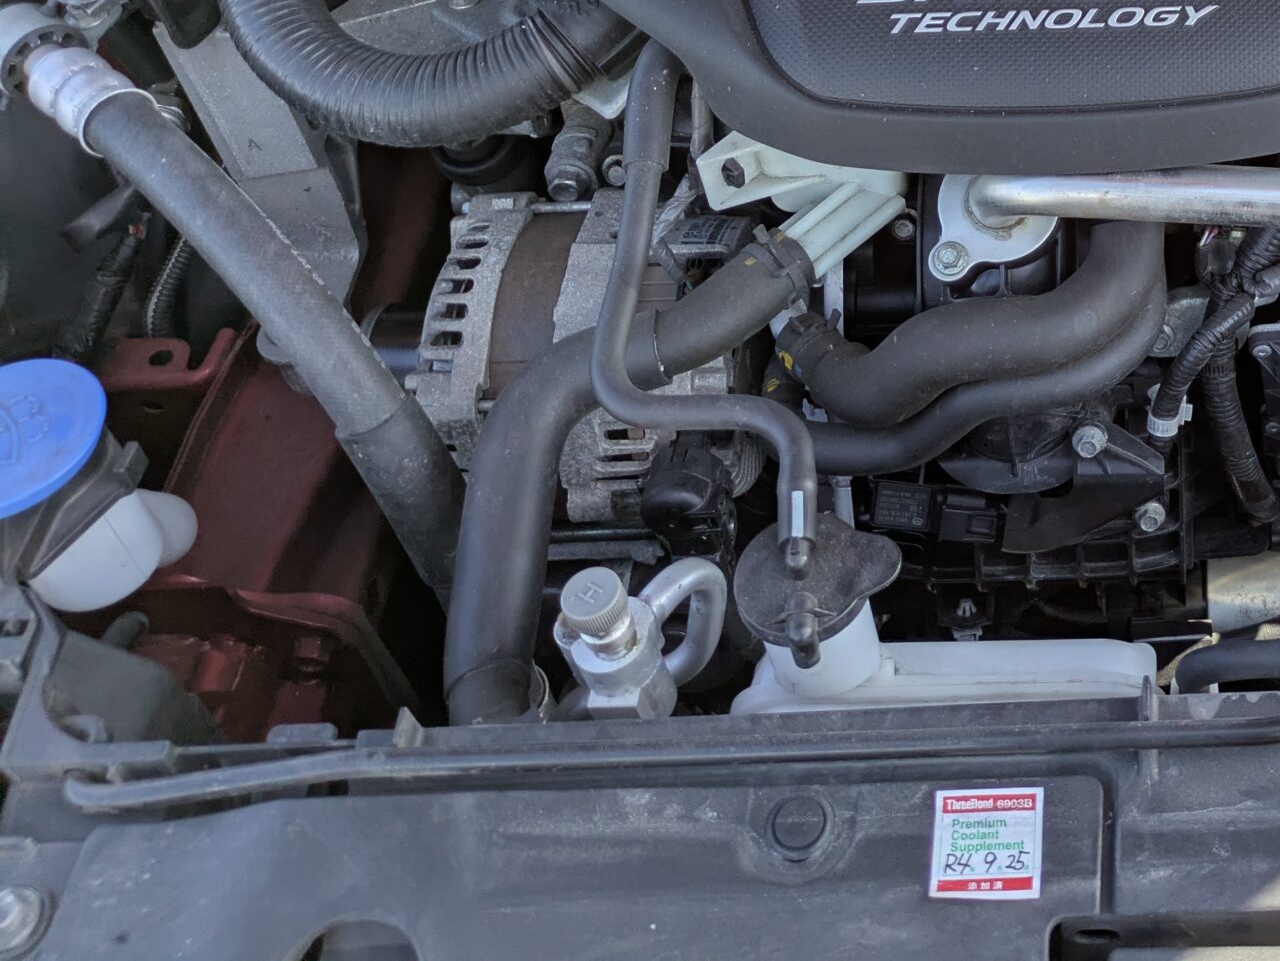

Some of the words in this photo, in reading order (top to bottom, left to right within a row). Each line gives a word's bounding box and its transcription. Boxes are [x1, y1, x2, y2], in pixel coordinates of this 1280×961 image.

[890, 4, 1220, 34] TECHNOLOGY
[577, 581, 604, 604] H
[945, 798, 994, 810] ThreeBond
[996, 798, 1033, 808] 6903B
[951, 818, 1007, 829] Premium
[951, 829, 999, 841] Coolant
[950, 840, 1025, 854] Supplement
[944, 853, 973, 875] R4
[984, 851, 998, 873] 9
[1005, 851, 1031, 870] 25
